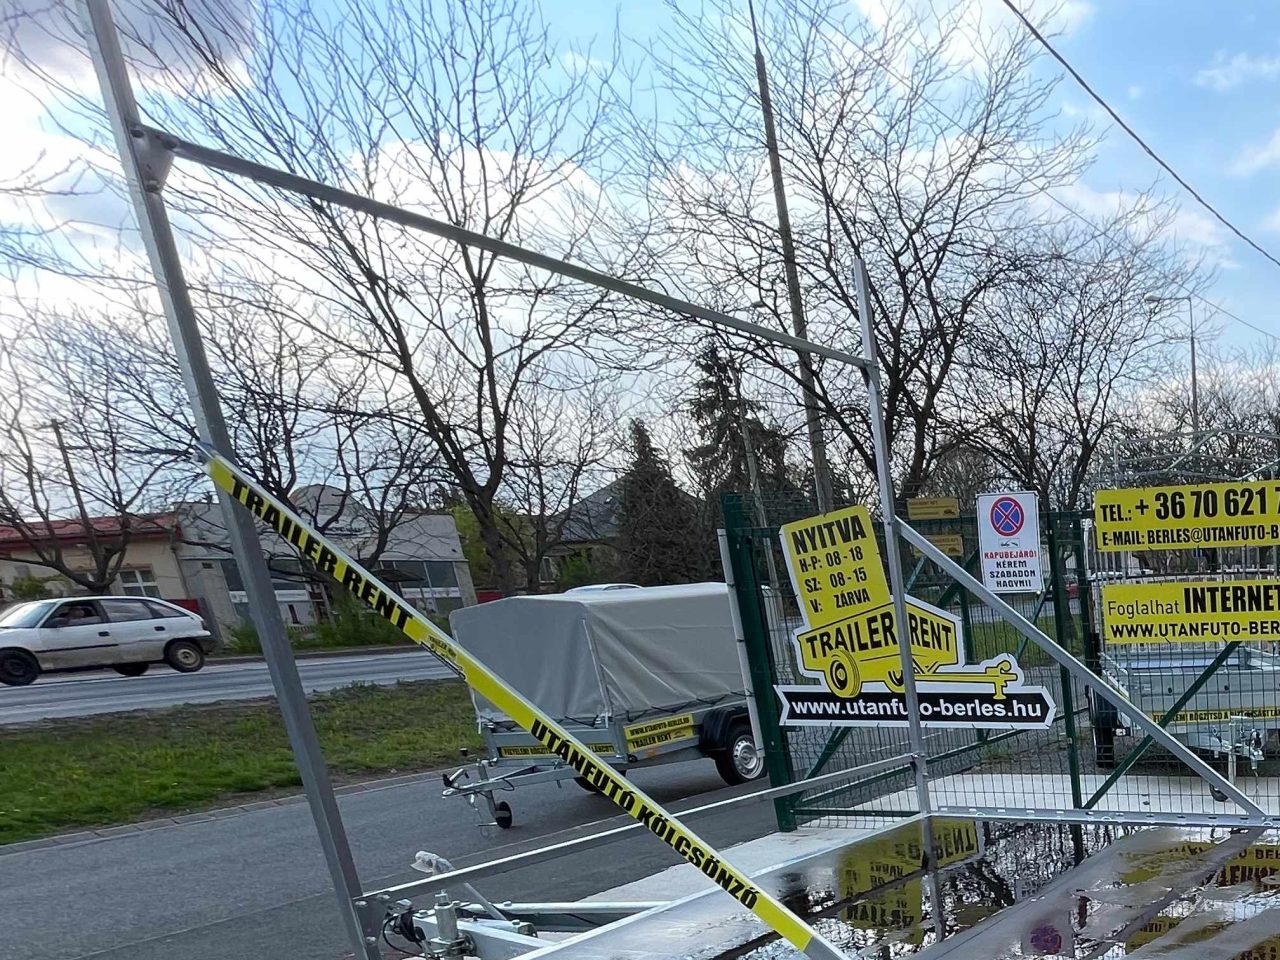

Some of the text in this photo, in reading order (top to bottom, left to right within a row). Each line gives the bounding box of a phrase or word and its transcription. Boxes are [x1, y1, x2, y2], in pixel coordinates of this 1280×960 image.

[1100, 504, 1132, 522] TEL.:
[1154, 491, 1185, 520] 36
[1190, 490, 1218, 518] 70
[1224, 487, 1267, 517] 621
[791, 515, 867, 555] NYITVA
[1102, 531, 1145, 546] E-MAIL:
[231, 474, 414, 629] TRAILER RENT
[799, 555, 823, 573] H-P:
[996, 560, 1027, 569] KÉREM
[989, 570, 1036, 579] SZABADON
[804, 577, 822, 593] SZ:
[810, 588, 871, 614] V: ZÁRVA
[1108, 600, 1180, 620] Foglalhat
[806, 613, 952, 659] TRAILER RENT
[791, 698, 1042, 717] www.utanfuo-berles.hu
[530, 718, 635, 812] UTÁNFUTÓ
